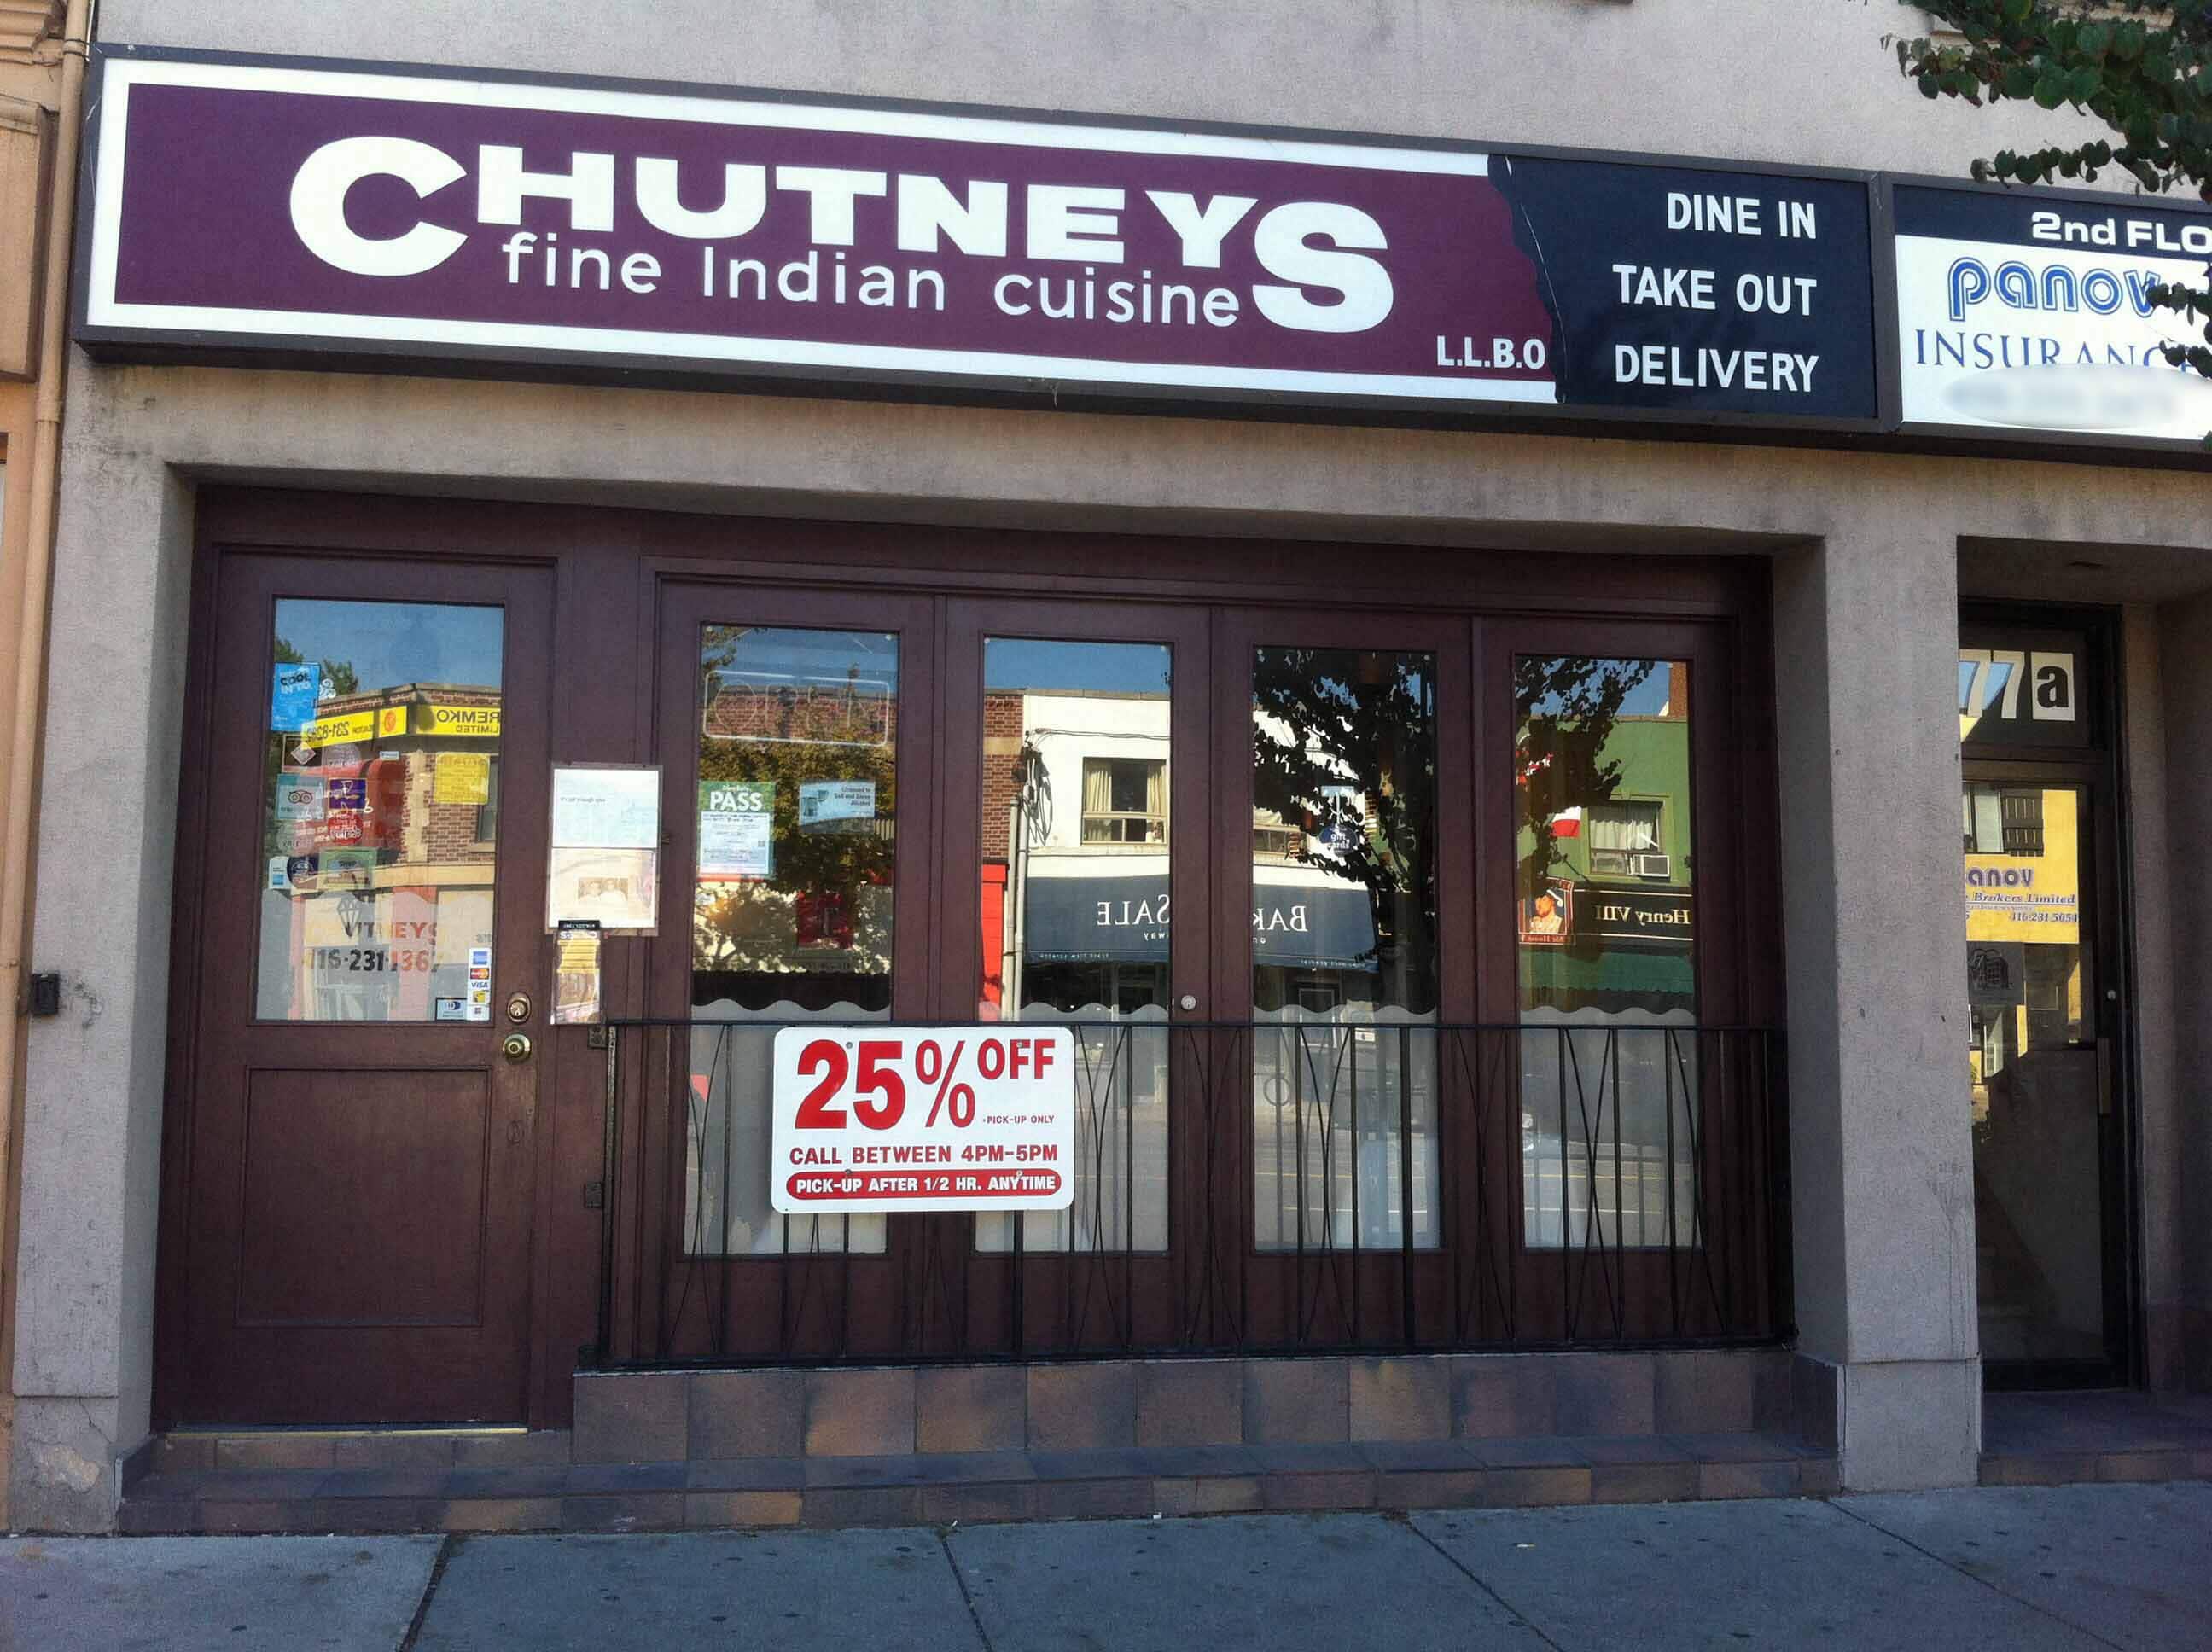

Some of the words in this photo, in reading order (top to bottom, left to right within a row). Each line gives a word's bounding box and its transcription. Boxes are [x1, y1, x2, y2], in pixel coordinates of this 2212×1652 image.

[290, 136, 1394, 333] CHUTNEYS
[1667, 191, 1762, 235] DINE
[1778, 199, 1816, 239] IN
[2031, 212, 2116, 246] 2nd
[501, 232, 662, 294] fine
[704, 244, 944, 311] Indian
[994, 266, 1240, 328] cuisine
[1612, 264, 1715, 311] TAKE
[1736, 272, 1817, 317] OUT
[1615, 344, 1819, 393] DELIVERY
[709, 791, 763, 811] PASS
[1974, 893, 2023, 902] Brokers
[2027, 894, 2075, 904] Limited
[795, 1038, 976, 1131] 25%
[977, 1038, 1056, 1080] OFF
[1031, 1114, 1055, 1124] ONLY
[789, 1147, 842, 1165] CALL
[853, 1145, 952, 1164] BETWEEN
[961, 1144, 1057, 1162] 4PM-5PM
[796, 1177, 863, 1193] PICK-UP
[868, 1178, 917, 1192] AFTER
[924, 1177, 949, 1191] 1/2
[956, 1177, 981, 1191] HR.
[988, 1176, 1056, 1190] ANYTIME
